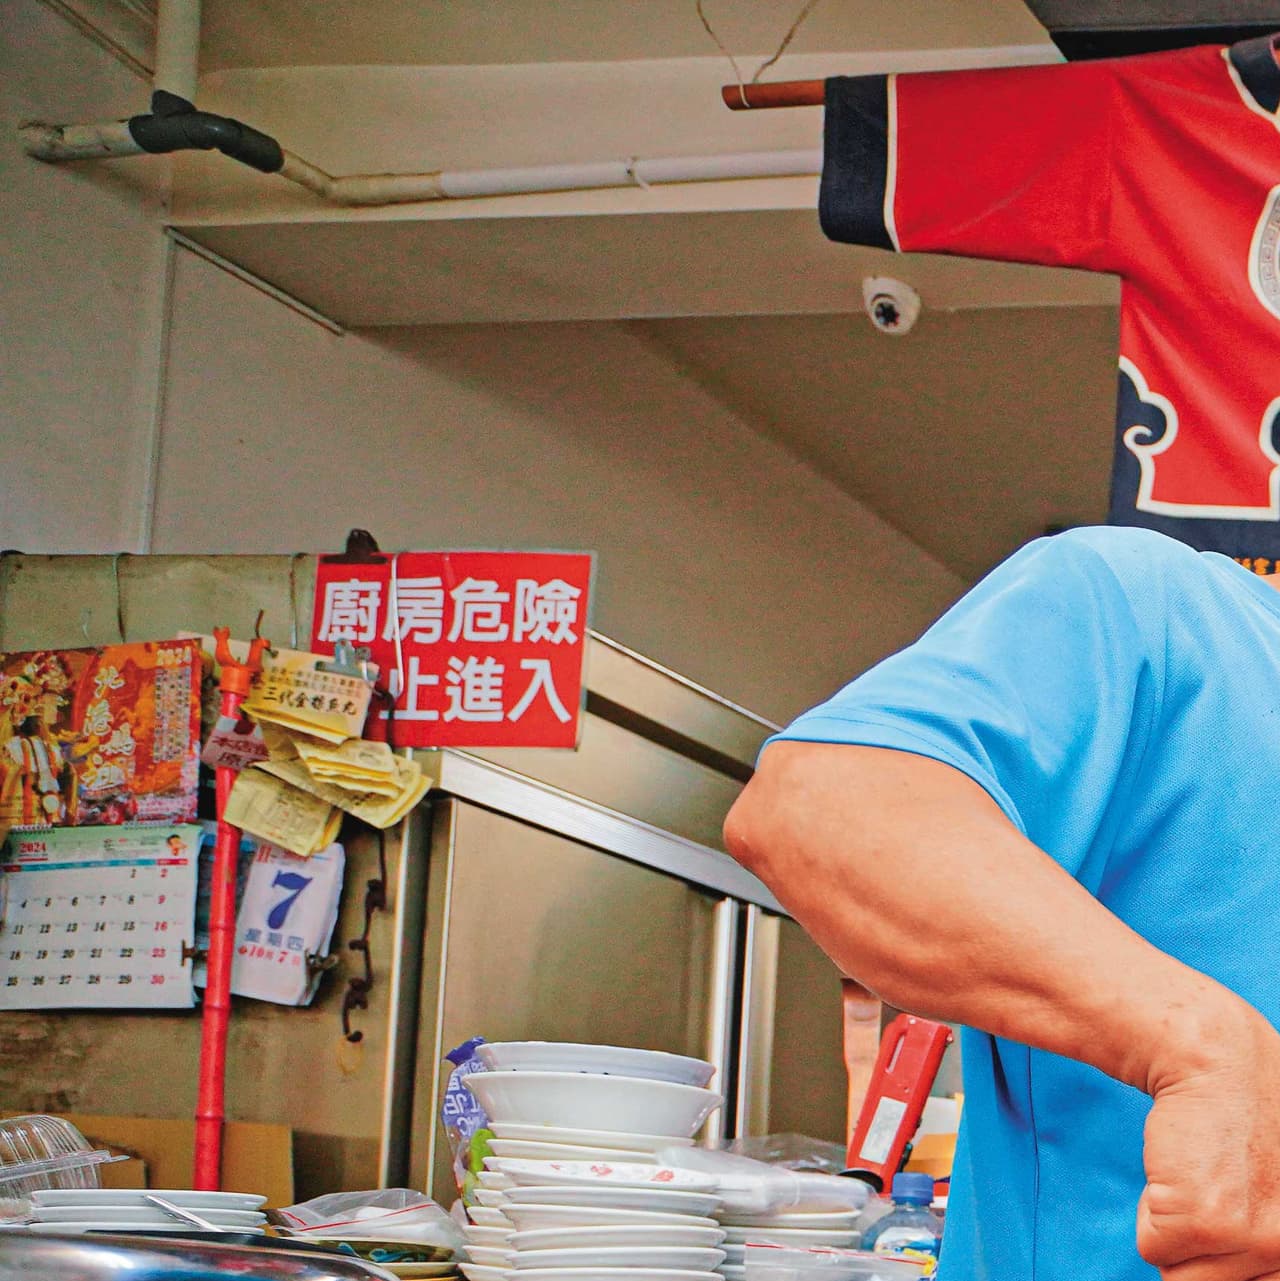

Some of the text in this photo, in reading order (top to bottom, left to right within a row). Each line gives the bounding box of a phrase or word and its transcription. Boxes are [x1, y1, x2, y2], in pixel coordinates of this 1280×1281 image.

[317, 576, 582, 646] 廚房危險
[379, 655, 572, 724] 止進入
[266, 870, 314, 930] 7
